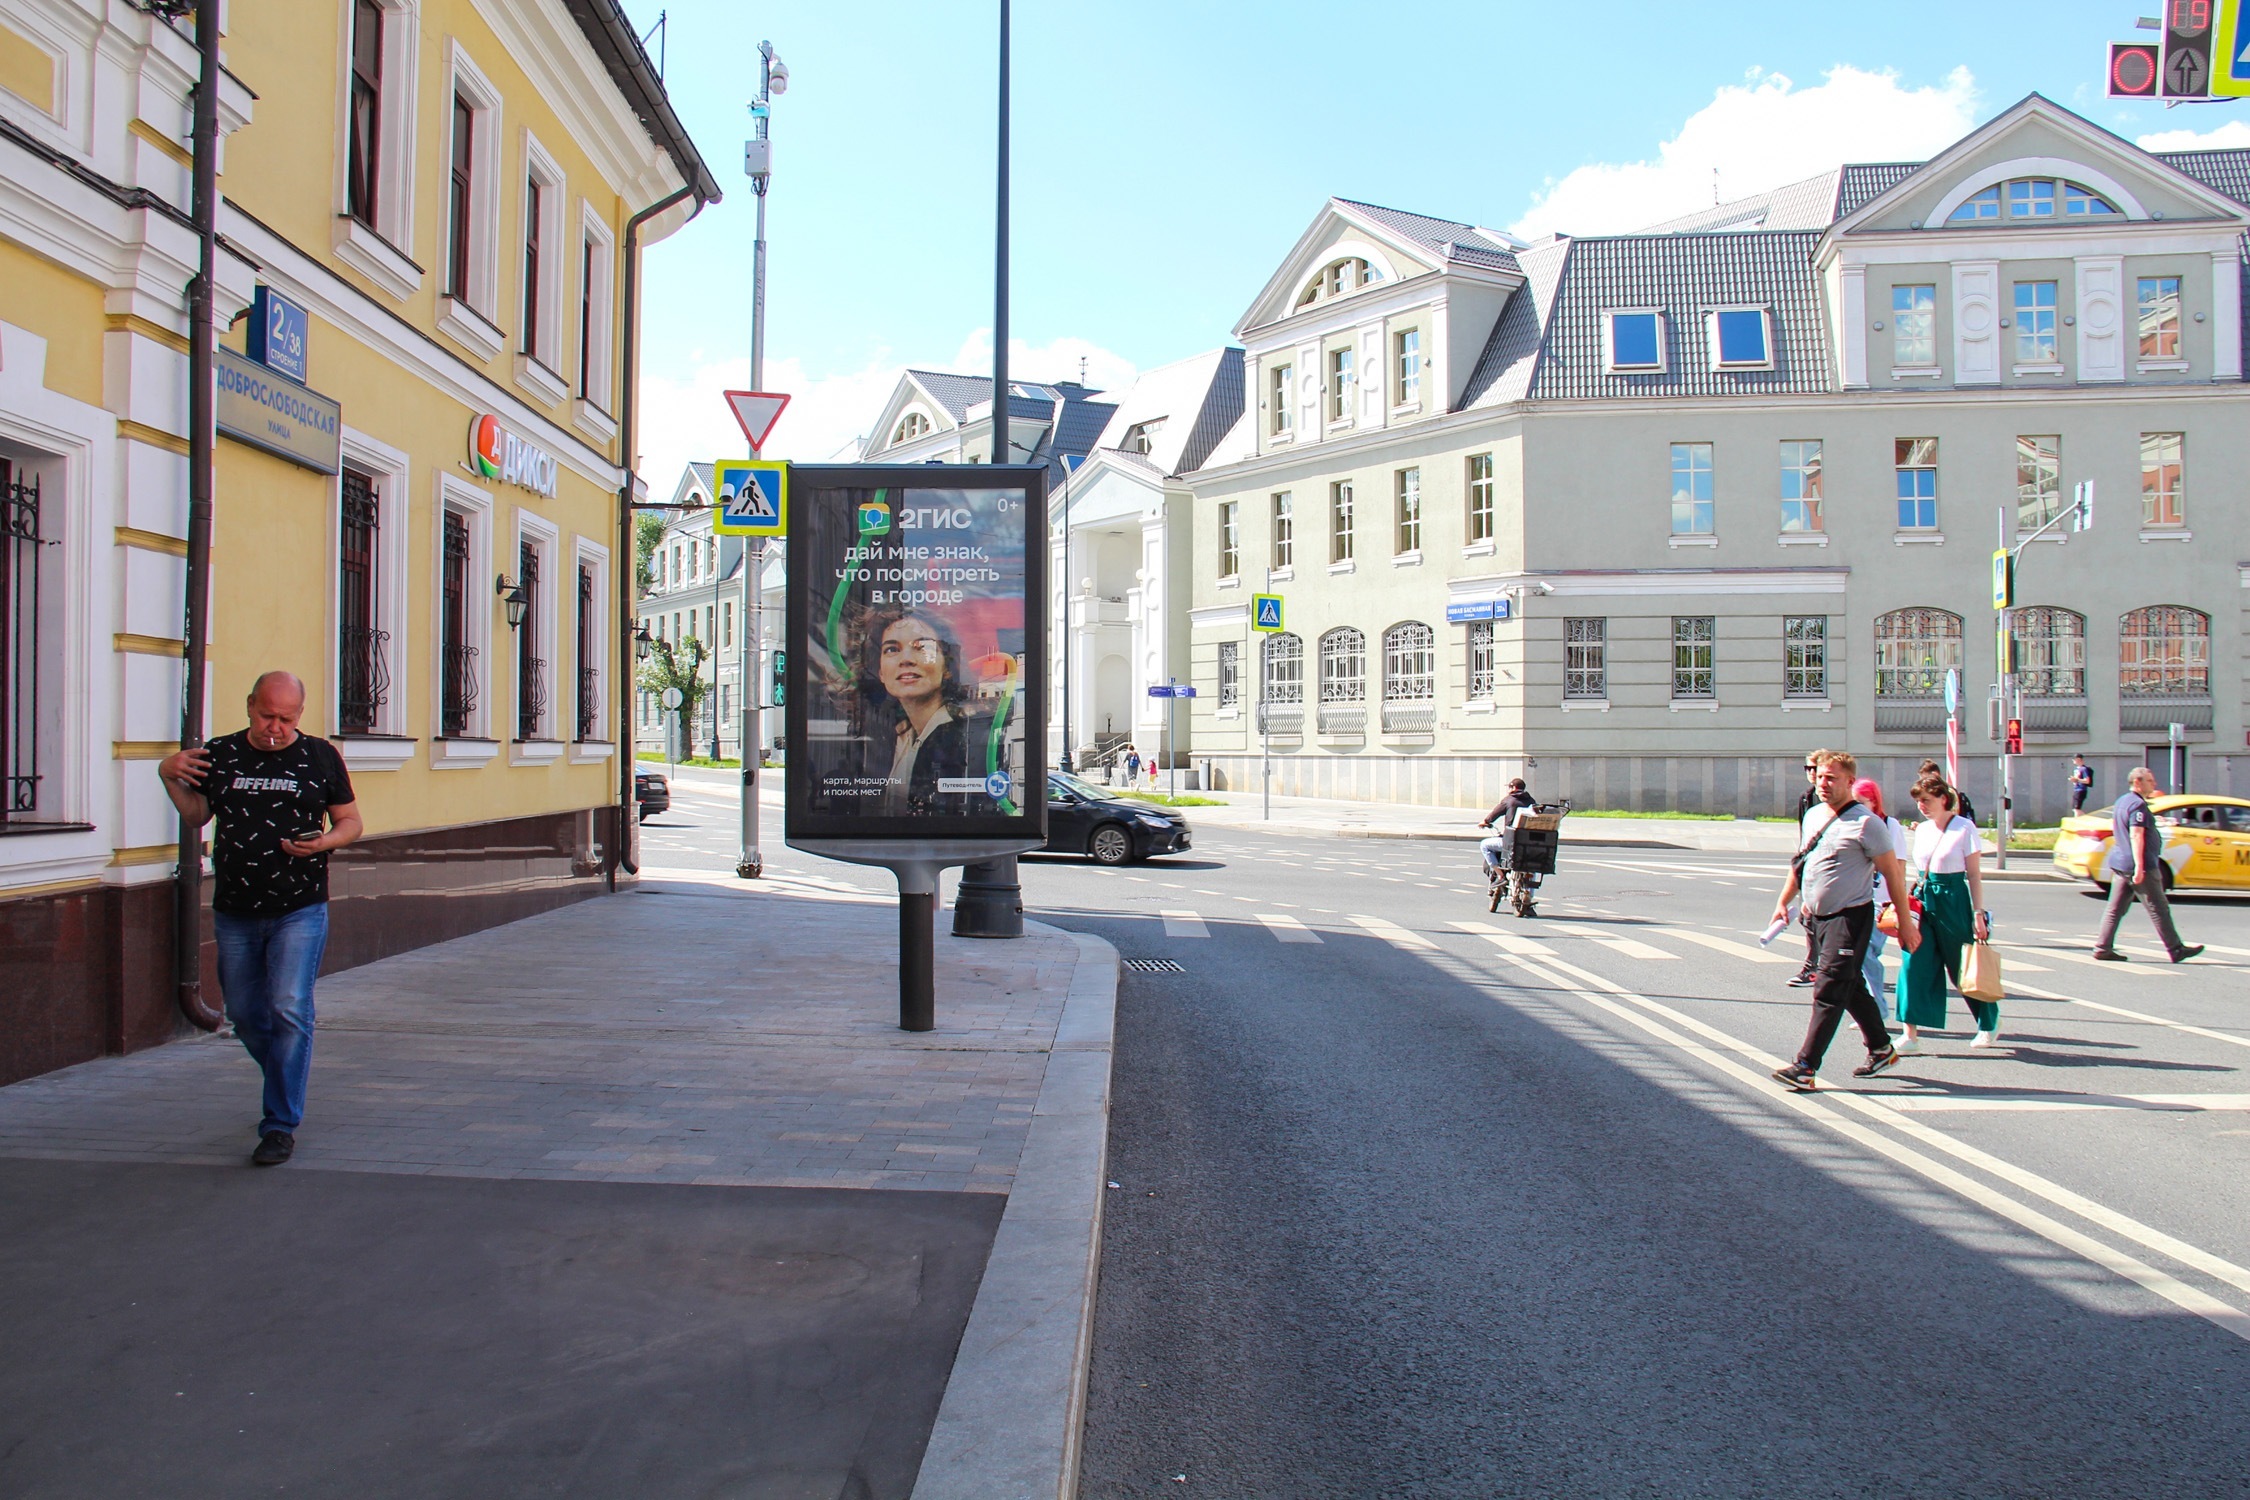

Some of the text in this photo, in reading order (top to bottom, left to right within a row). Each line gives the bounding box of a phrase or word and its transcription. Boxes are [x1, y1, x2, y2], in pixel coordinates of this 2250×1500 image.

[2173, 1, 2209, 29] 19
[270, 348, 298, 371] СТРОЕНИЕ
[218, 363, 335, 436] ДОБРОСЛОБОДСКАЯ
[268, 419, 291, 440] УЛИЦА
[503, 432, 557, 499] ДИКСИ
[997, 498, 1019, 513] 0+
[898, 508, 972, 529] 2ГИС
[844, 541, 990, 563] дай мне знак,
[835, 568, 1000, 585] что посмотреть
[872, 590, 963, 607] в городе
[232, 777, 298, 792] OFFLINE
[823, 777, 902, 786] карта, маршруты
